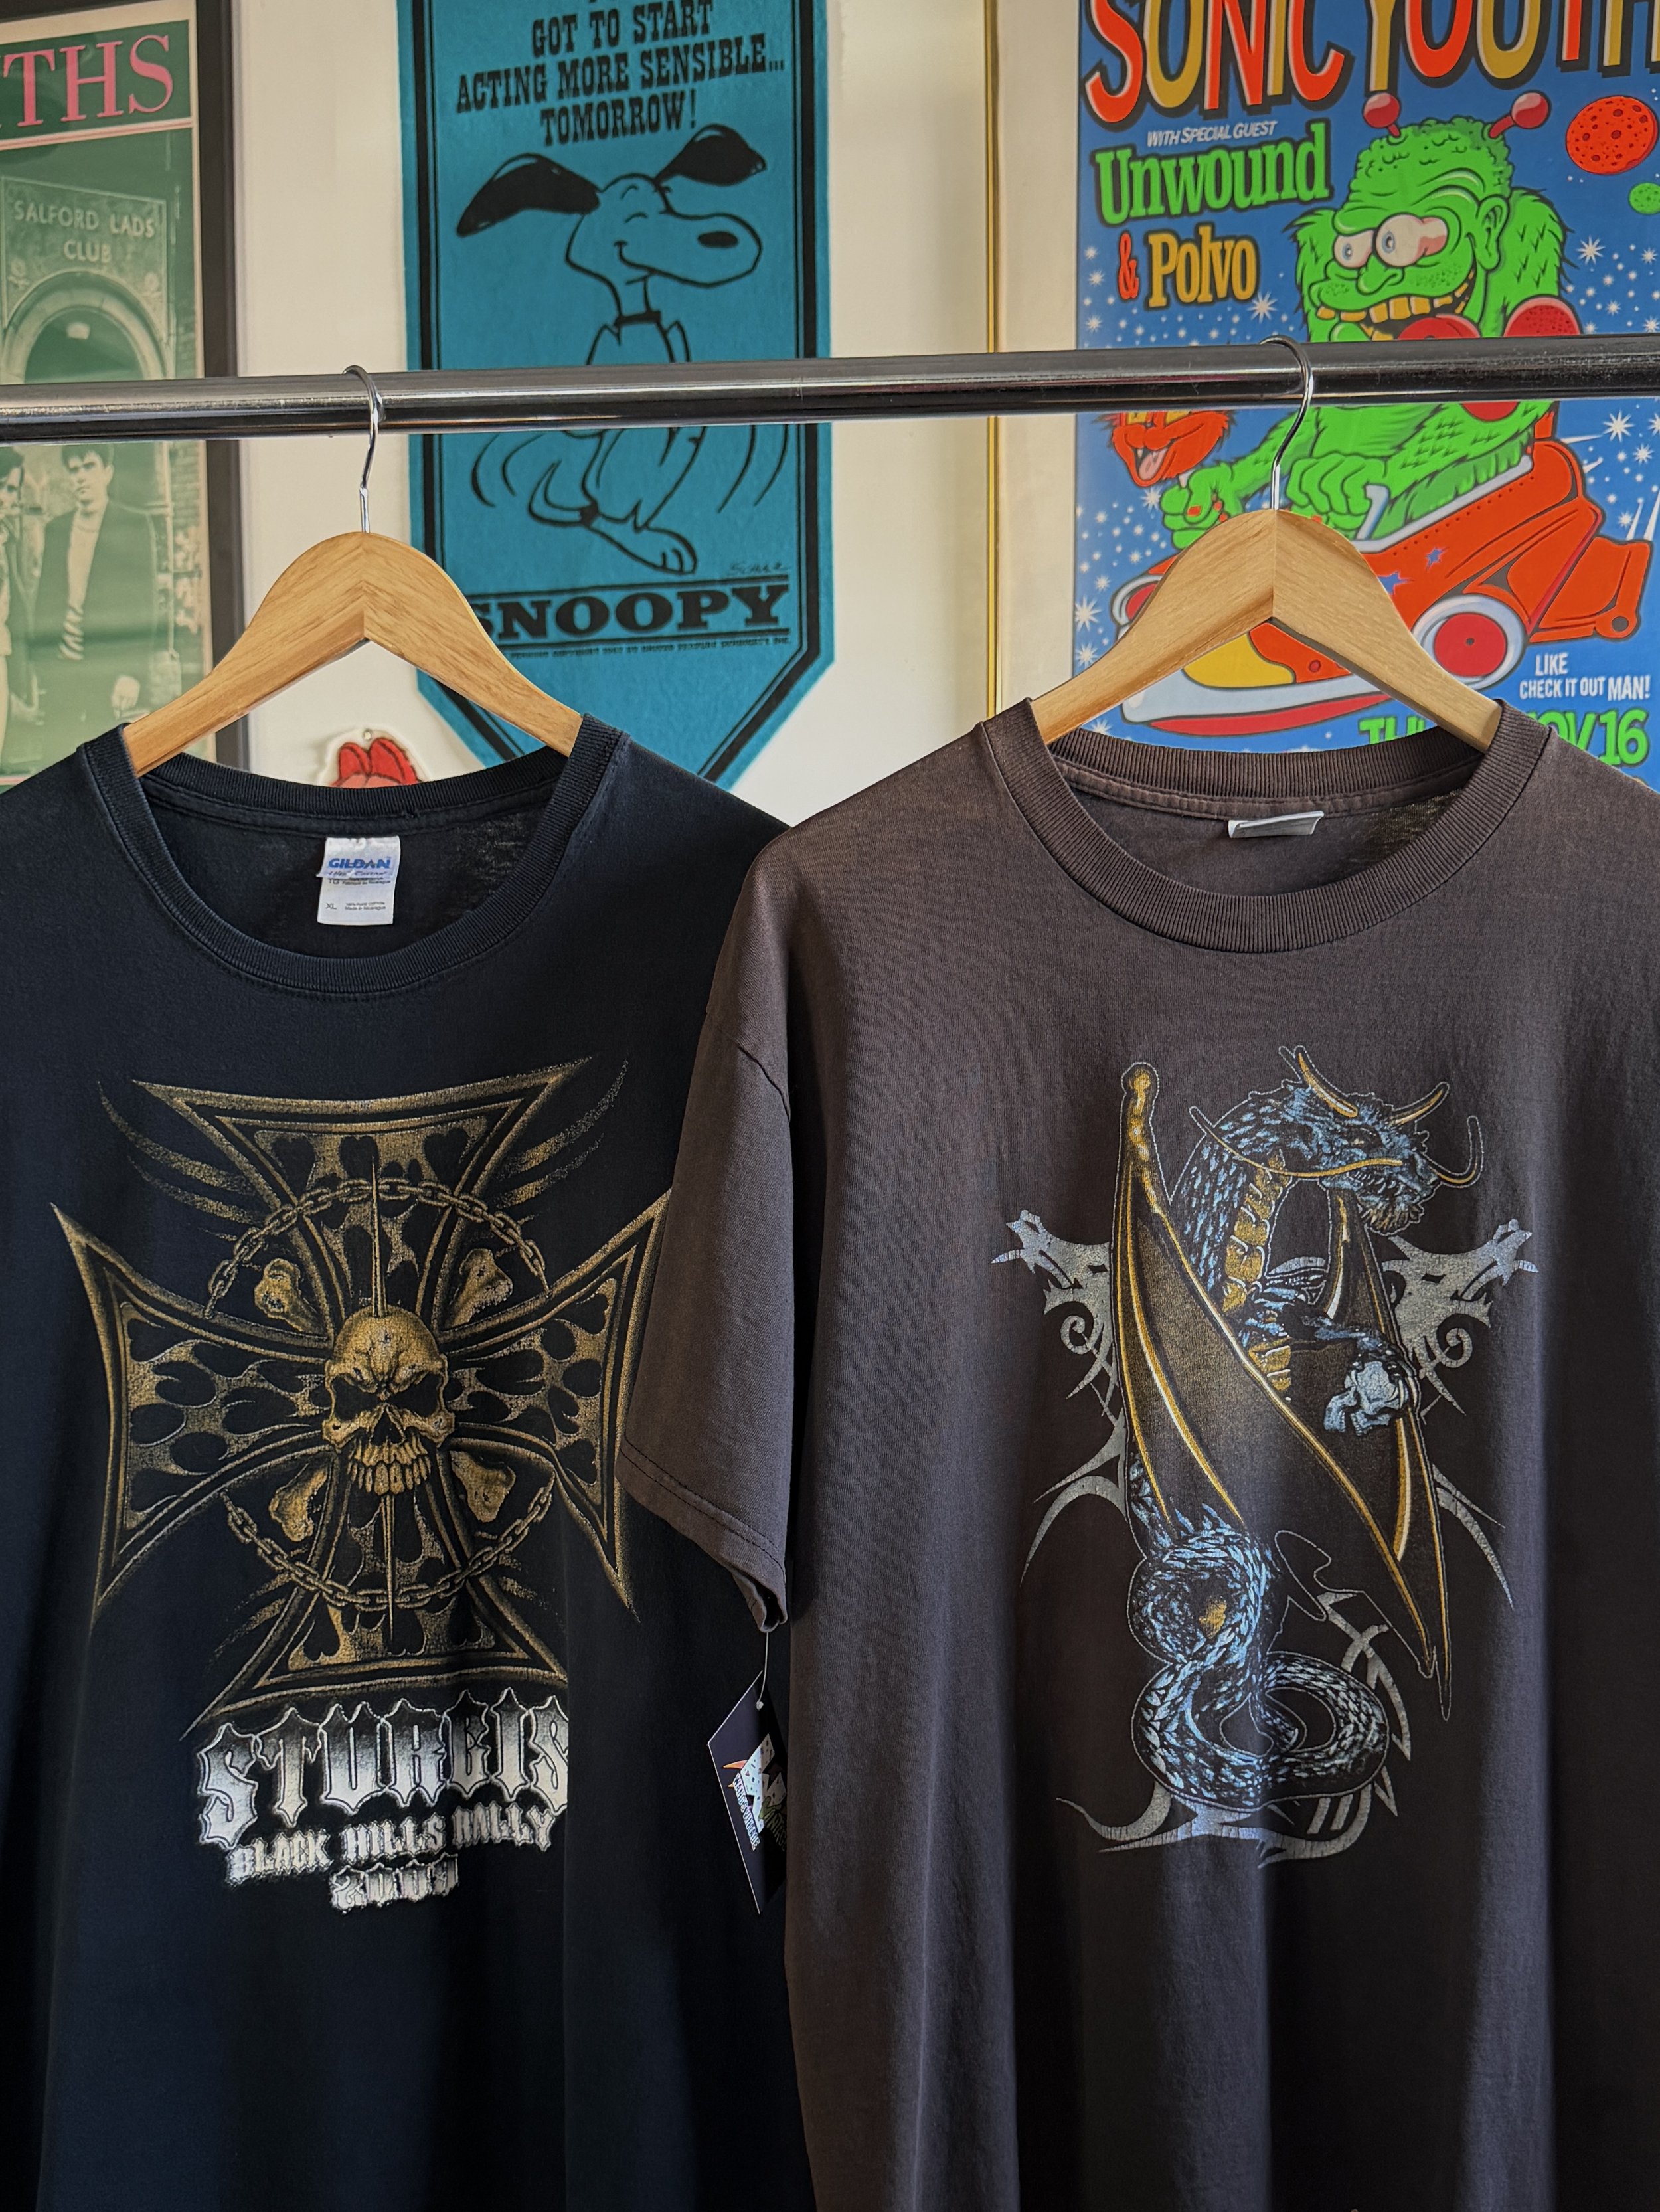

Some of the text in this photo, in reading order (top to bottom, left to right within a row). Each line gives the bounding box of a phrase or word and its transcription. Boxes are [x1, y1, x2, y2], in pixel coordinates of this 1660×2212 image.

[533, 0, 713, 58] GOT TO START
[457, 33, 785, 113] ACTING MORE SENSIBLE...
[1084, 0, 1348, 126] SONIC
[540, 89, 697, 147] TOMORROW!
[1147, 120, 1278, 147] WITH SPECIAL GUEST
[1095, 122, 1330, 224] Unwound
[15, 200, 156, 239] SALFORD LADS
[63, 238, 112, 264] CLUB
[1118, 226, 1257, 307] & Polvo
[1519, 674, 1651, 701] CHECK IT OUT MAN!
[1535, 652, 1569, 677] LIKE
[1527, 710, 1596, 751] OV
[1598, 708, 1648, 765] 16
[328, 857, 391, 869] GILDAN
[197, 1687, 569, 1851] STURGIS
[226, 1800, 556, 1888] BLACK HILLS RALLY
